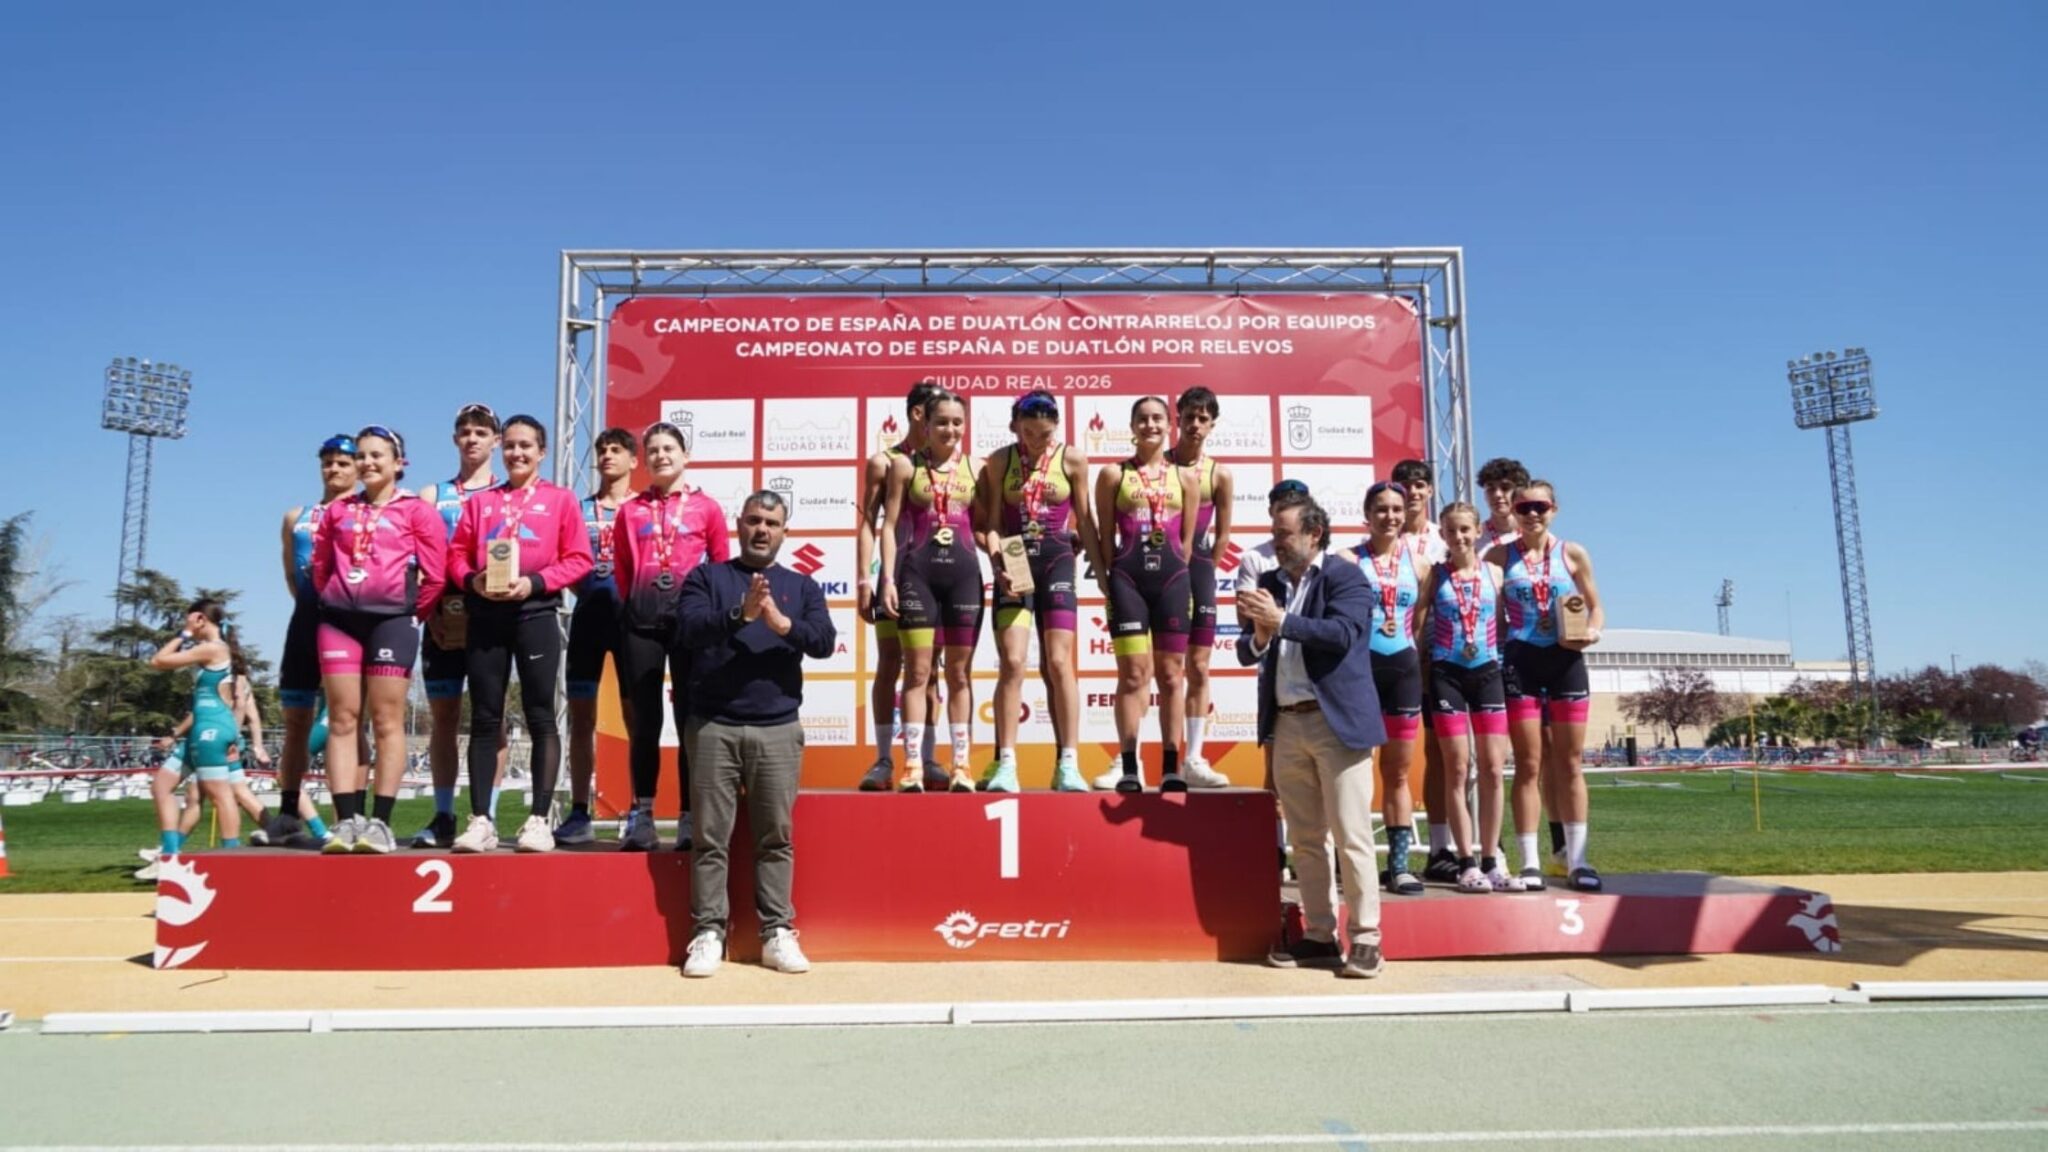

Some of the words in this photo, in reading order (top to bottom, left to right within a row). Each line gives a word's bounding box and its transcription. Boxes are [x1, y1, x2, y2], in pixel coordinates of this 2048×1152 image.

[654, 317, 800, 333] CAMPEONATO
[806, 317, 833, 332] DE
[840, 313, 922, 332] ESPAÑA
[929, 316, 955, 330] DE
[962, 313, 1061, 331] DUATLÓN
[1067, 314, 1232, 331] CONTRARRELOJ
[1239, 315, 1280, 329] POR
[1286, 315, 1376, 330] EQUIPOS
[736, 341, 883, 357] CAMPEONATO
[889, 341, 916, 356] DE
[923, 337, 1006, 355] ESPAÑA
[1012, 340, 1039, 355] DE
[1046, 335, 1145, 355] DUATLÓN
[1152, 339, 1194, 354] POR
[1201, 339, 1293, 355] RELEVOS
[1006, 375, 1057, 390] REAL
[1063, 374, 1112, 389] 2026
[699, 430, 726, 438] Ciudad
[728, 430, 746, 438] Real
[1318, 426, 1344, 434] Ciudad
[1347, 426, 1364, 434] Real
[767, 442, 816, 451] CIUDAD
[820, 441, 849, 450] REAL
[1206, 439, 1231, 448] DAD
[1236, 438, 1266, 448] REAL
[799, 497, 827, 505] Ciudad
[829, 497, 847, 505] Real
[984, 798, 1020, 879] 1
[412, 859, 453, 913] 2
[1555, 899, 1584, 936] 3
[976, 919, 1071, 938] fetri
